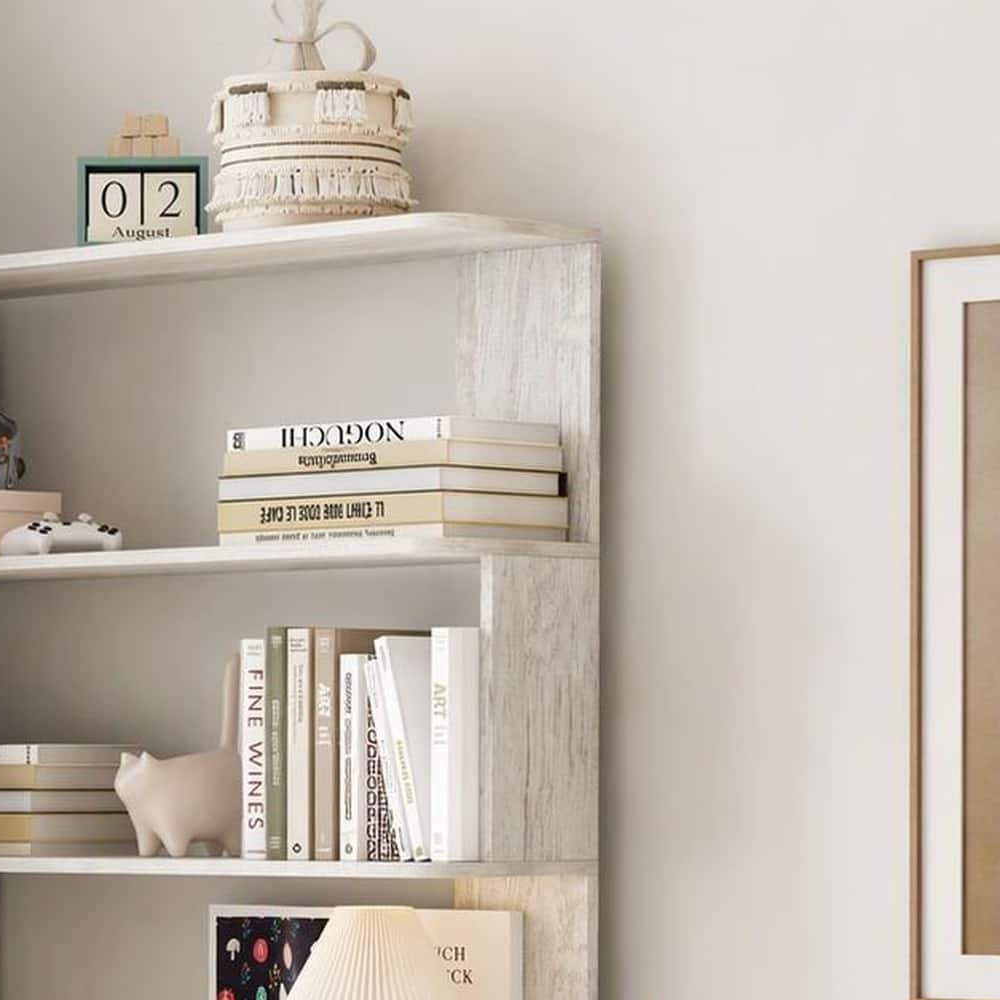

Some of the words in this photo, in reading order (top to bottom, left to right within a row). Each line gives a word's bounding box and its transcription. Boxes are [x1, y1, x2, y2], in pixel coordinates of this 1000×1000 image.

[111, 225, 171, 241] August
[281, 420, 405, 449] NOGUCHI
[247, 669, 264, 727] FINE
[247, 741, 264, 830] WINES
[437, 945, 466, 962] CH
[446, 968, 473, 985] CK
